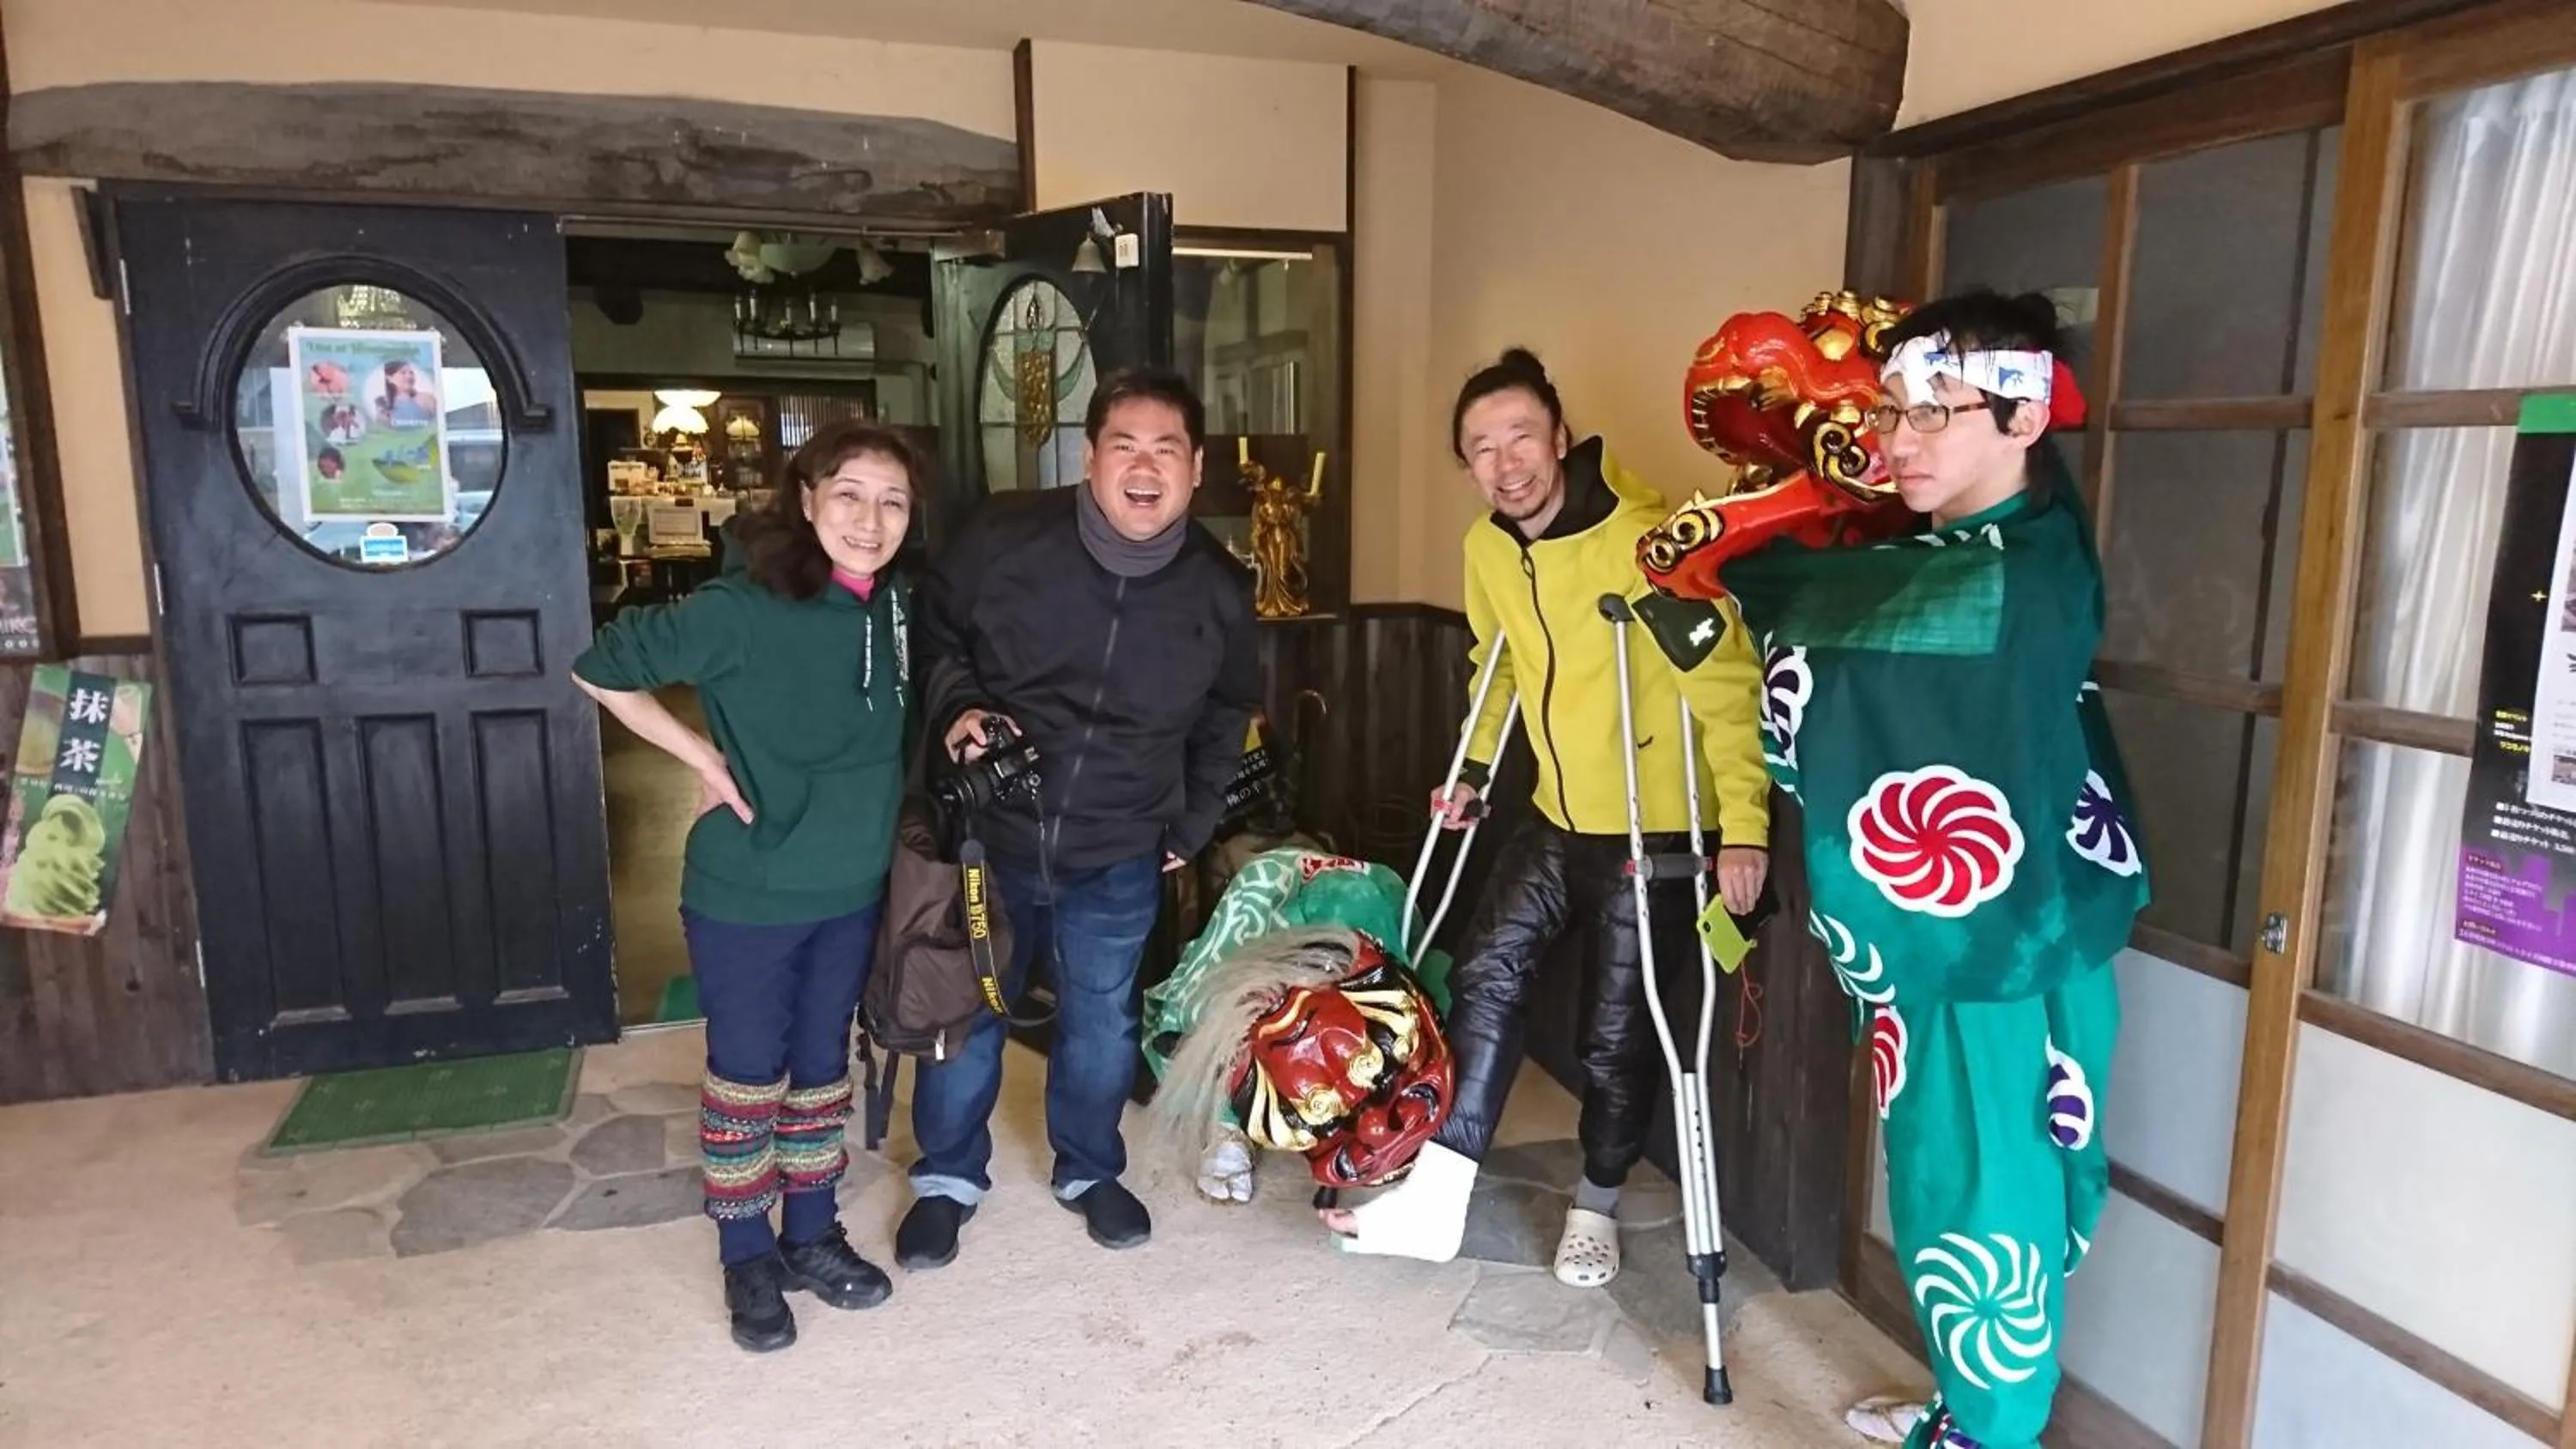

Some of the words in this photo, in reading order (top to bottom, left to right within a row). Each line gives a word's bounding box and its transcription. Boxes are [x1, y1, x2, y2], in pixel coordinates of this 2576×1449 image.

[59, 688, 110, 773] 抹茶
[968, 869, 981, 902] Nikon
[970, 904, 987, 939] D750
